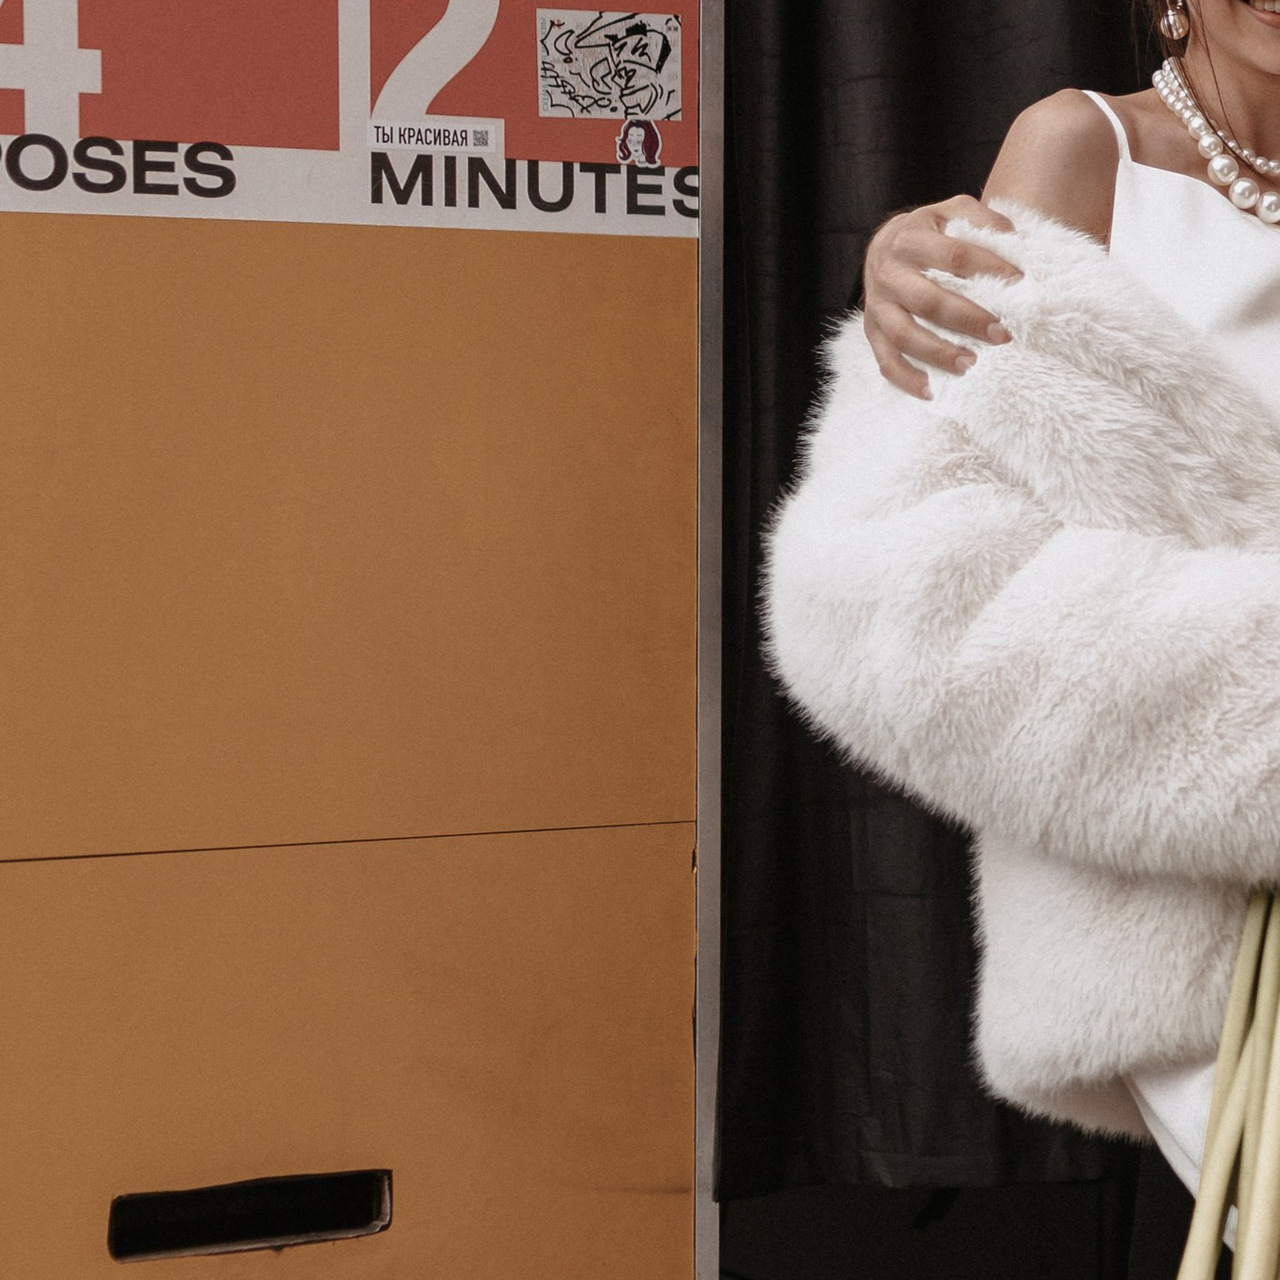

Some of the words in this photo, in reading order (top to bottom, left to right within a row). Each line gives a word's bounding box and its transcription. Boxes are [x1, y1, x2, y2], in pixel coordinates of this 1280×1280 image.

[0, 133, 236, 198] OSES
[374, 125, 393, 144] ТЫ
[399, 127, 468, 147] КРАСИВАЯ
[371, 152, 699, 218] MINUTES
